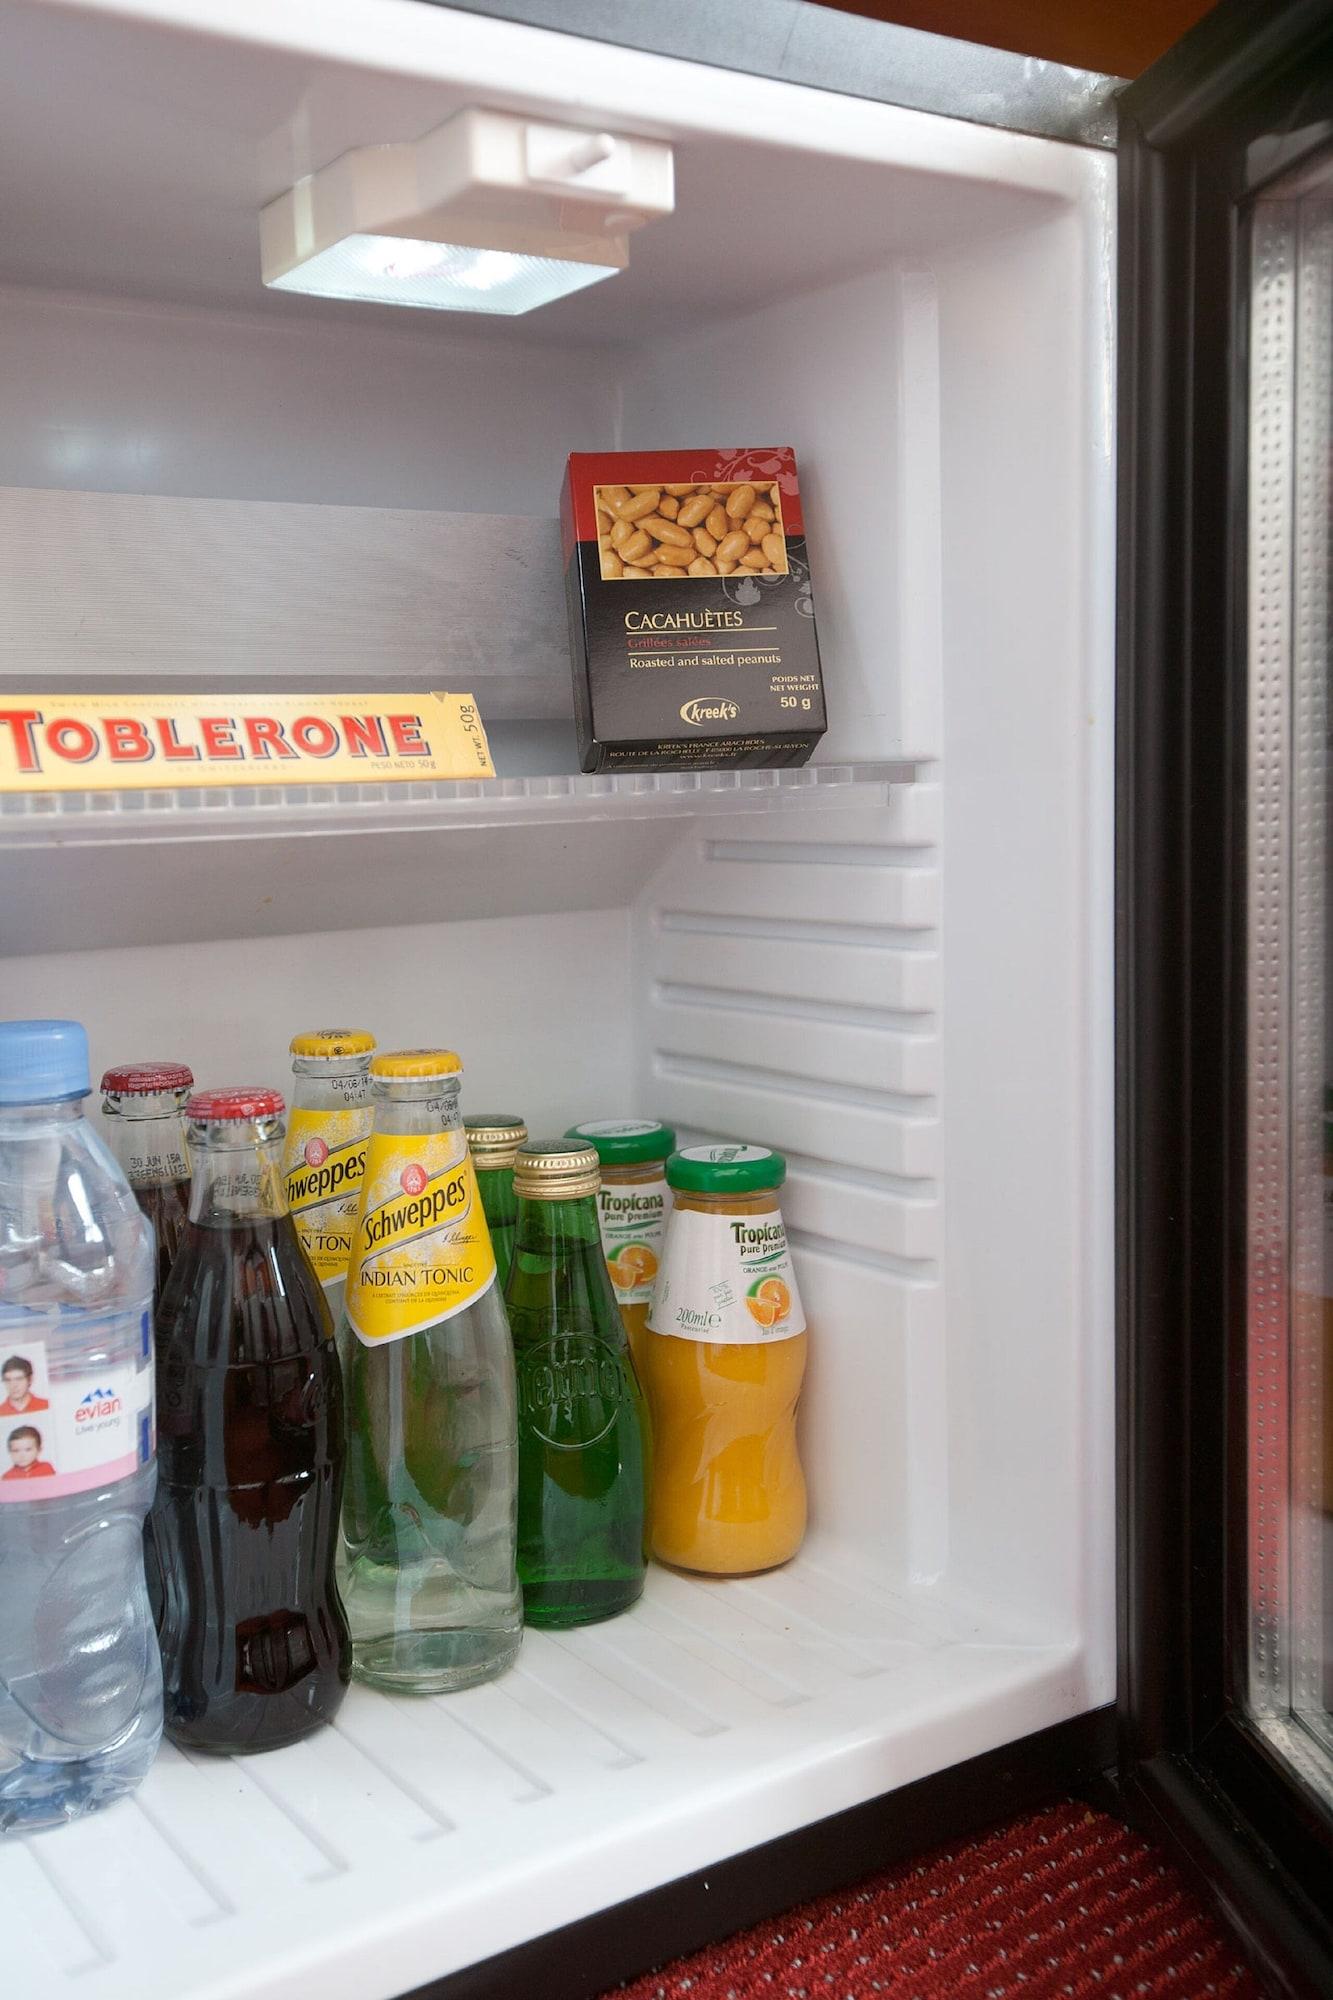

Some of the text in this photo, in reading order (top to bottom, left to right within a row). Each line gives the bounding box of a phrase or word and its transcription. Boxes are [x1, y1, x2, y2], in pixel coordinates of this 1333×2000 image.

[624, 609, 743, 630] CACAHUÈTES
[630, 653, 782, 669] Roasted and salted peanuts
[770, 683, 819, 692] NET WEIGHT
[772, 674, 816, 683] POIDS NET
[691, 702, 737, 722] kreek's
[780, 696, 811, 710] 50 g
[0, 709, 432, 774] TOBLERONE
[286, 1151, 367, 1202] hweppes
[598, 1190, 664, 1213] Tropicana
[364, 1175, 466, 1250] Schweppes
[316, 1235, 352, 1251] TON
[361, 1266, 474, 1287] INDIAN TONIC
[676, 1307, 709, 1327] 200ml
[74, 1397, 121, 1423] evian
